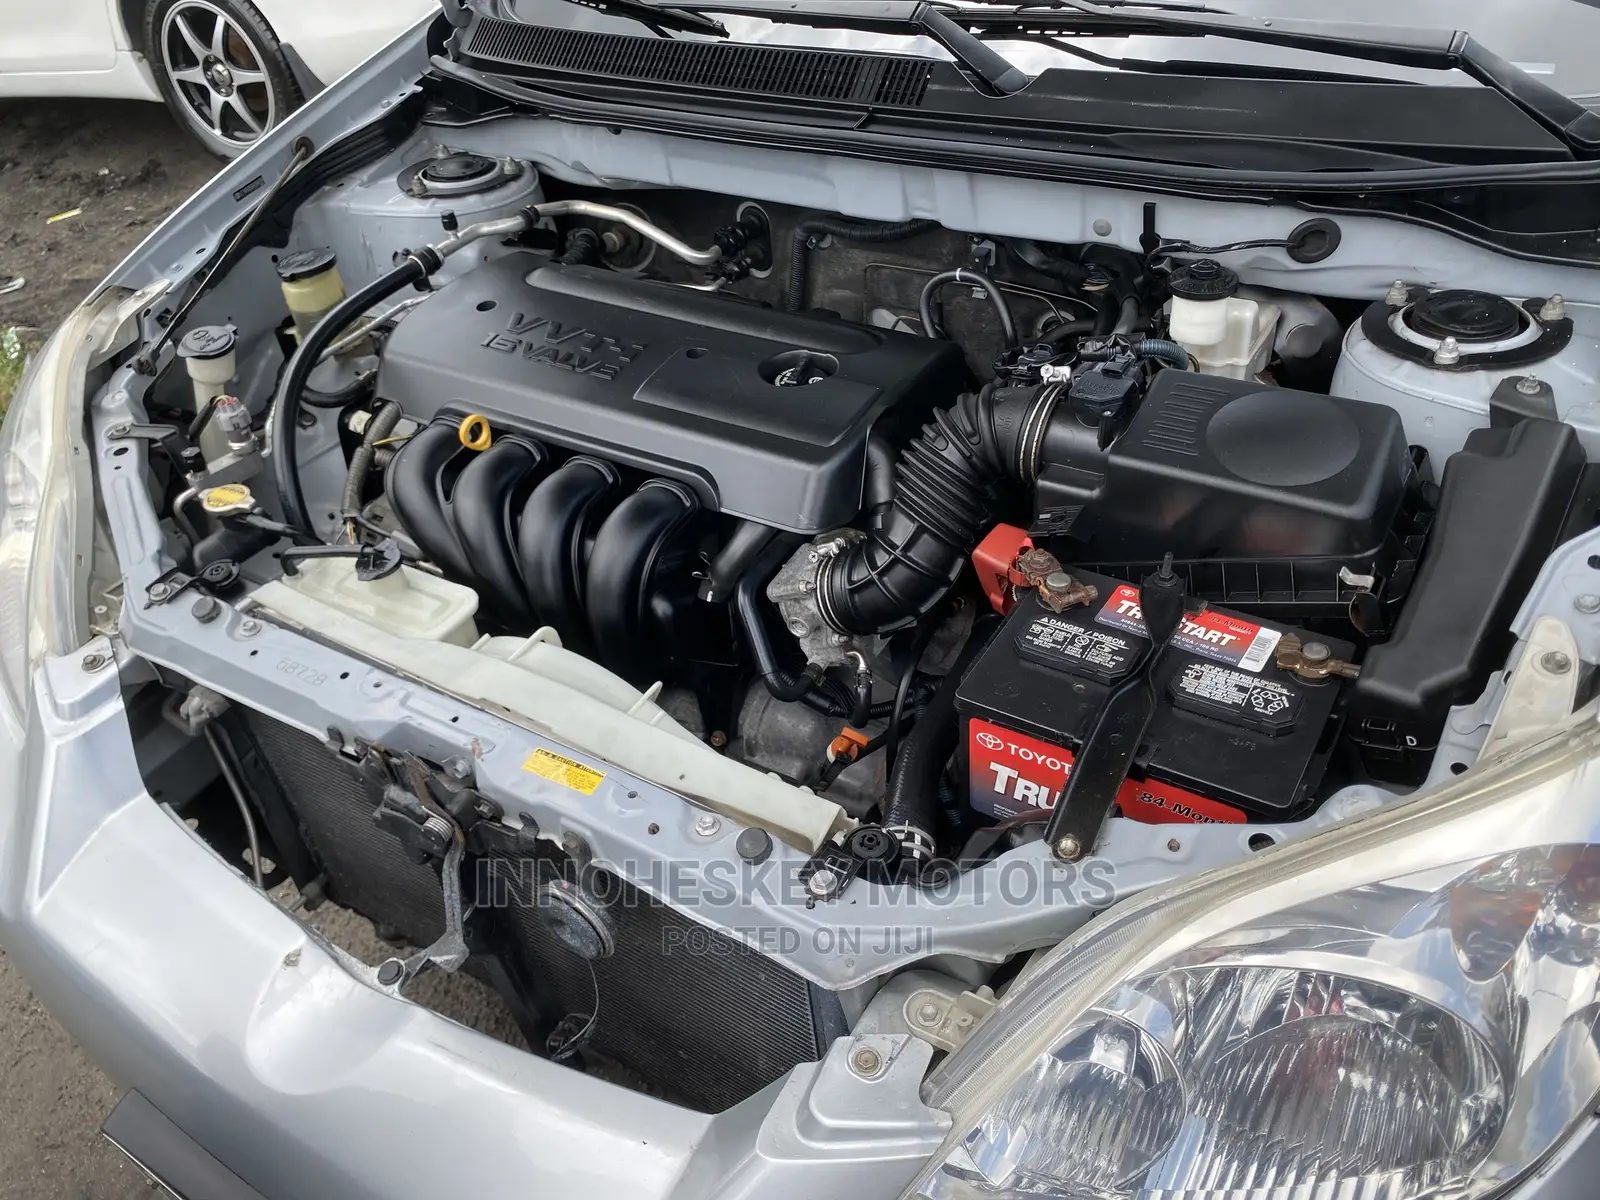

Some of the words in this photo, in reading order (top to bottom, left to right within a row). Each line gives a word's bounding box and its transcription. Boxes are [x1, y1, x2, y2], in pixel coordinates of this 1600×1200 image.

[1049, 618, 1085, 634] DANGER
[1092, 632, 1126, 646] POISON
[1405, 735, 1418, 746] D
[1006, 742, 1072, 776] TOYOT
[1139, 791, 1235, 824] 84-Mon
